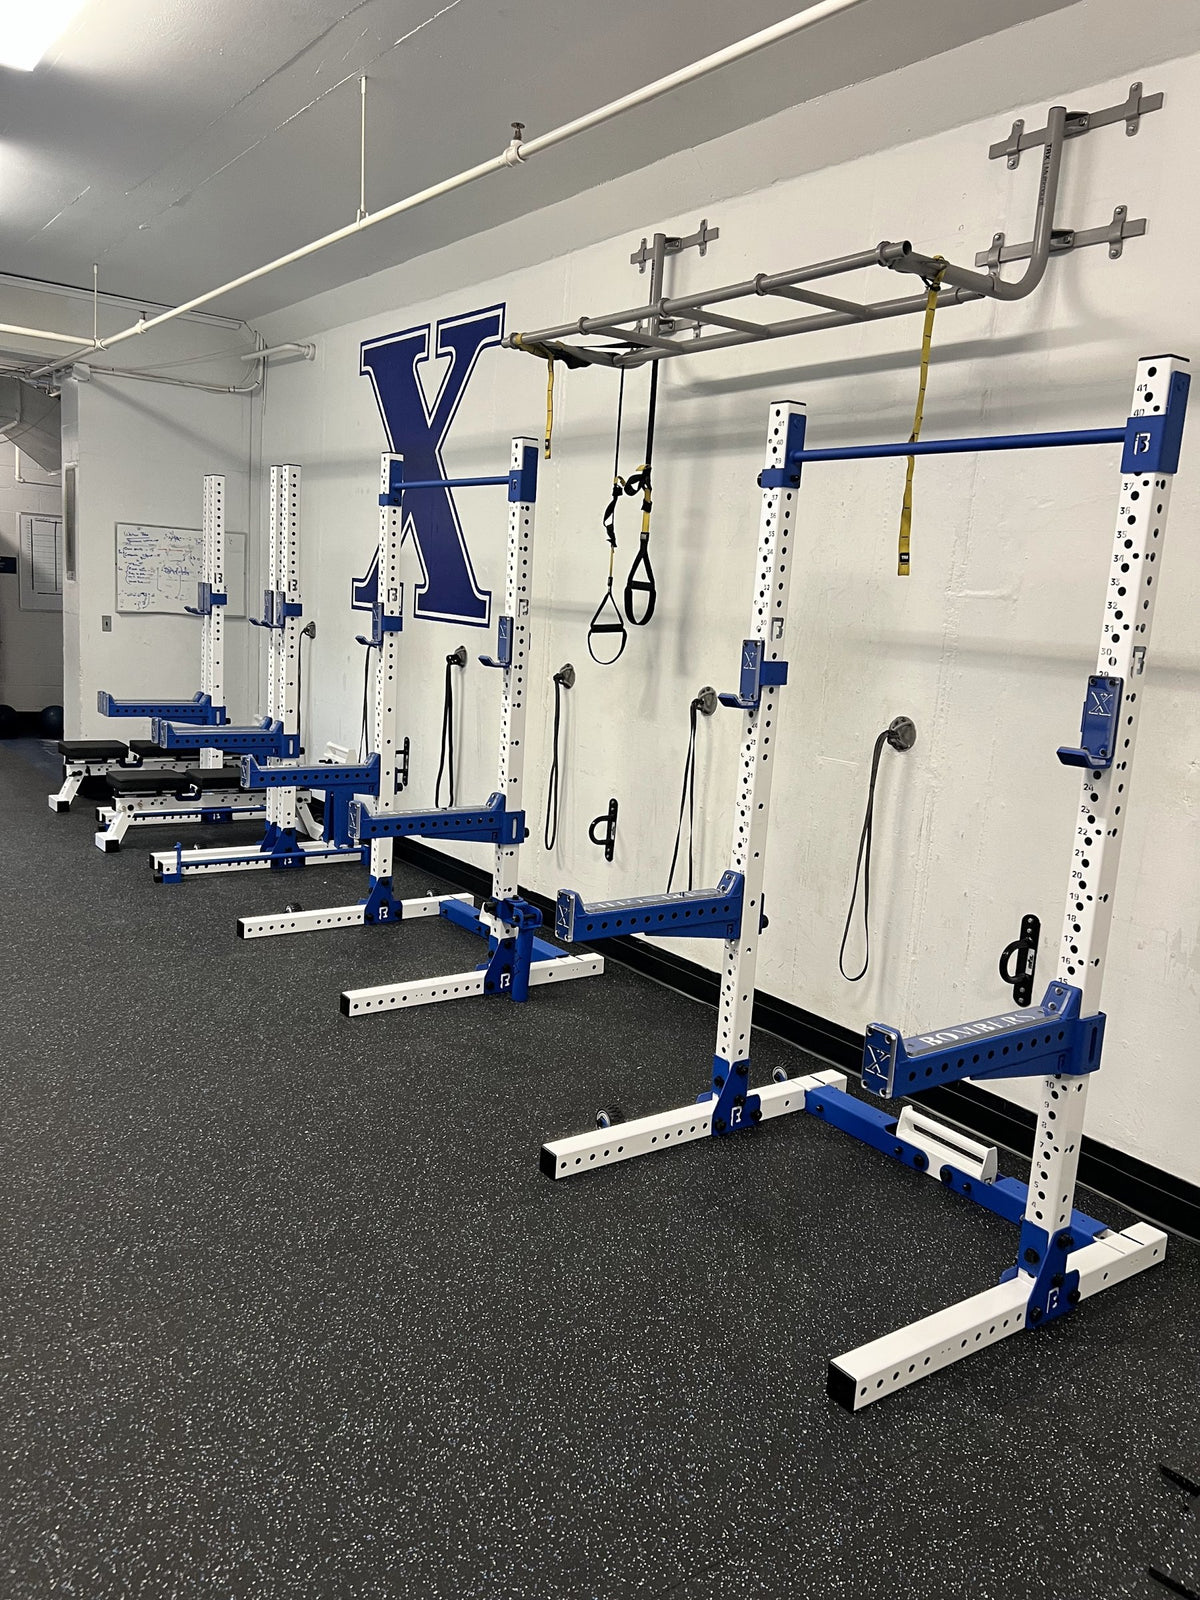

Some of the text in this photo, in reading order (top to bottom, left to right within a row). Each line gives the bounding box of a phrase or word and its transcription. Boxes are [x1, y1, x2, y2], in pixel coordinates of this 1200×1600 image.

[1044, 143, 1052, 160] TRX
[351, 301, 506, 628] X
[1123, 482, 1134, 491] 37
[1120, 507, 1131, 515] 36
[1116, 530, 1127, 538] 35
[1113, 554, 1124, 562] 34
[1110, 578, 1120, 586] 33
[1107, 602, 1118, 610] 32
[1101, 648, 1112, 656] 30
[1088, 692, 1114, 716] X
[1078, 827, 1088, 835] 22
[1074, 849, 1085, 857] 21
[1072, 870, 1082, 879] 20
[1069, 892, 1080, 901] 19
[1066, 914, 1077, 922] 18
[1064, 935, 1074, 943] 17
[1061, 956, 1071, 964] 16
[918, 1013, 1036, 1046] BOMBERS
[864, 1044, 891, 1080] X
[1045, 1080, 1055, 1089] 10
[1044, 1101, 1050, 1109] 9
[1036, 1161, 1042, 1169] 6
[1034, 1181, 1039, 1189] 5
